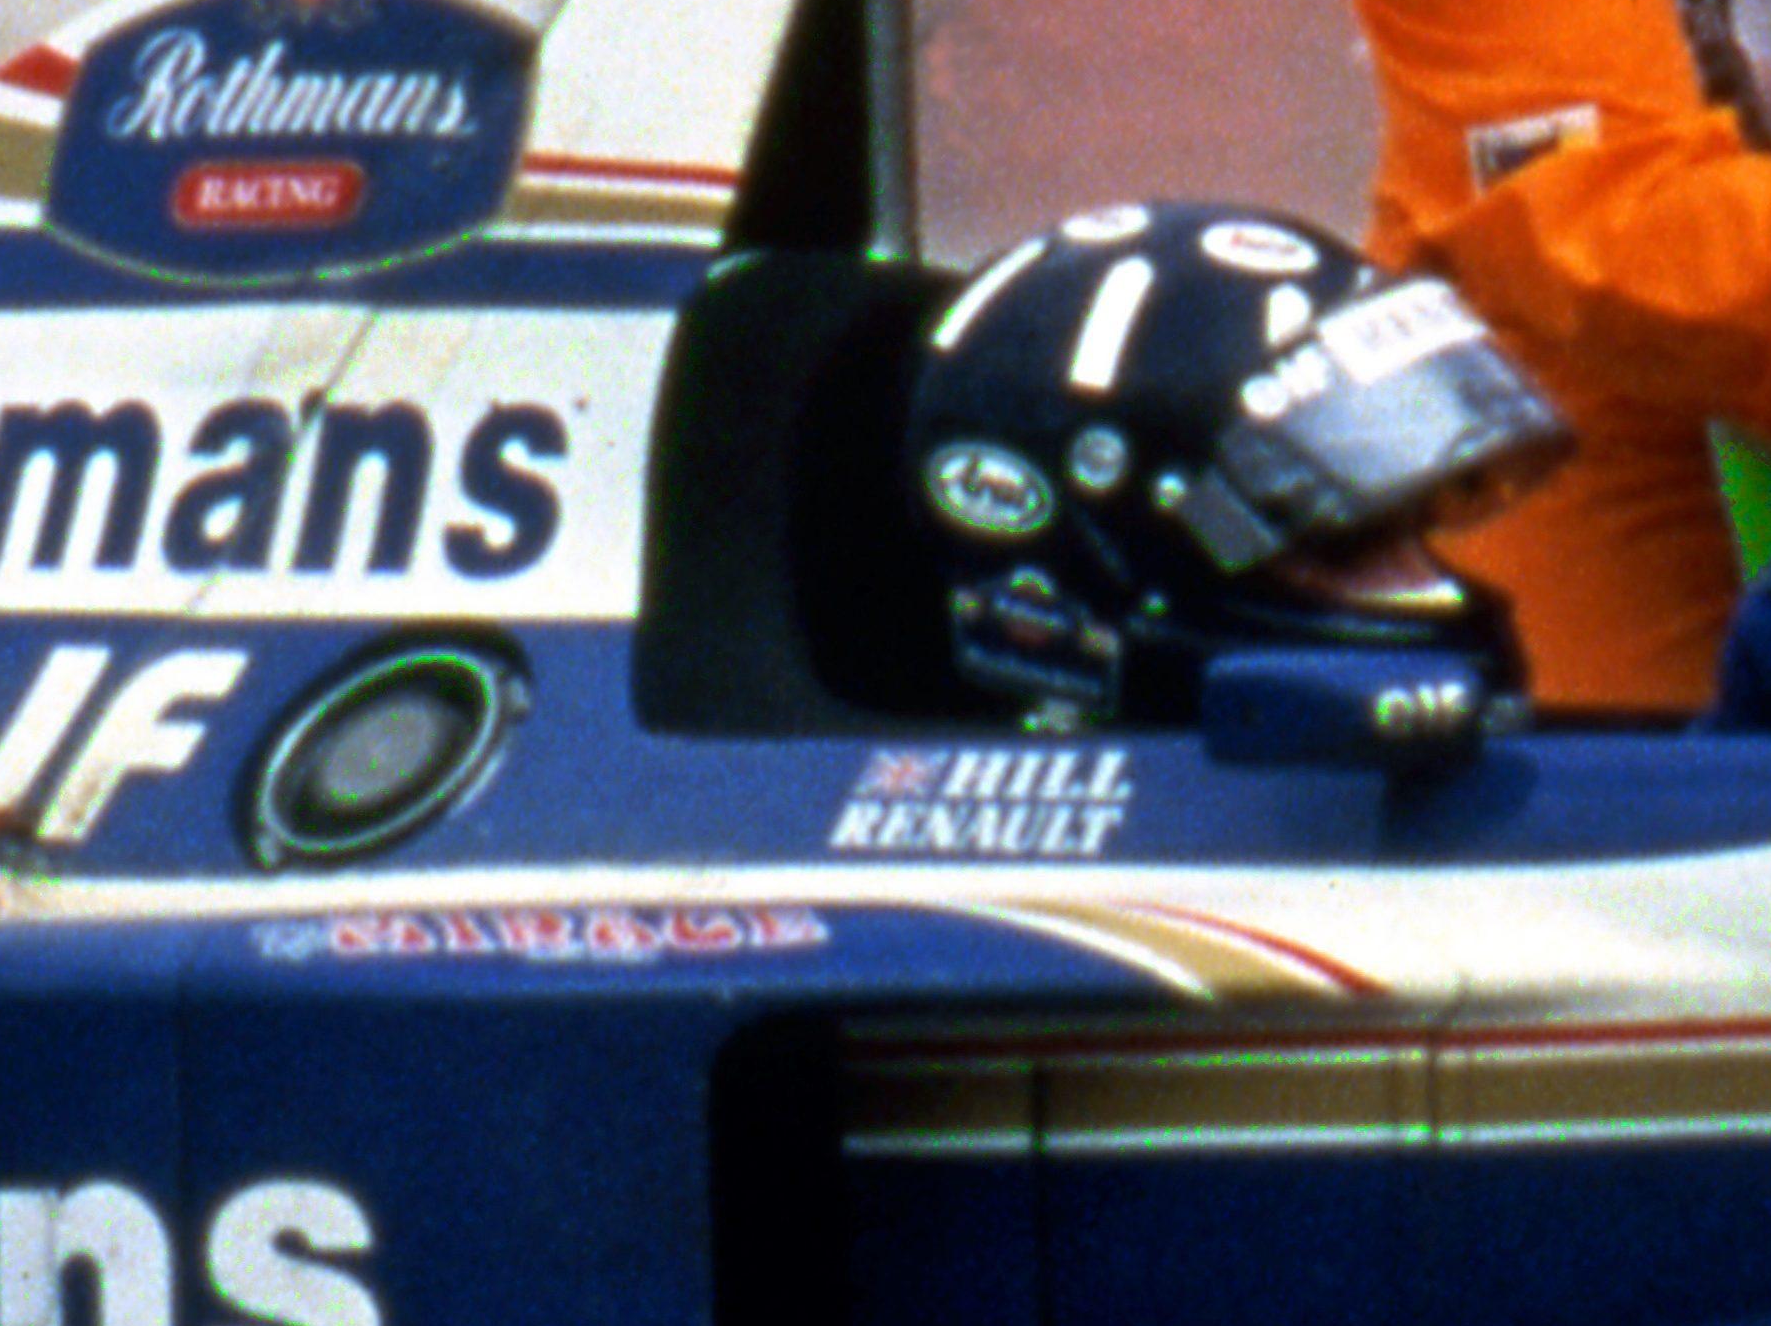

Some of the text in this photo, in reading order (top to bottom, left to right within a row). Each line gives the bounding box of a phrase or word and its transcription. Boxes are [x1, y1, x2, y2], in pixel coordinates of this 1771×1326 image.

[103, 28, 481, 143] Rothmans
[196, 172, 342, 215] RACING
[943, 750, 1134, 799] HILL
[829, 805, 1125, 854] RENAULT
